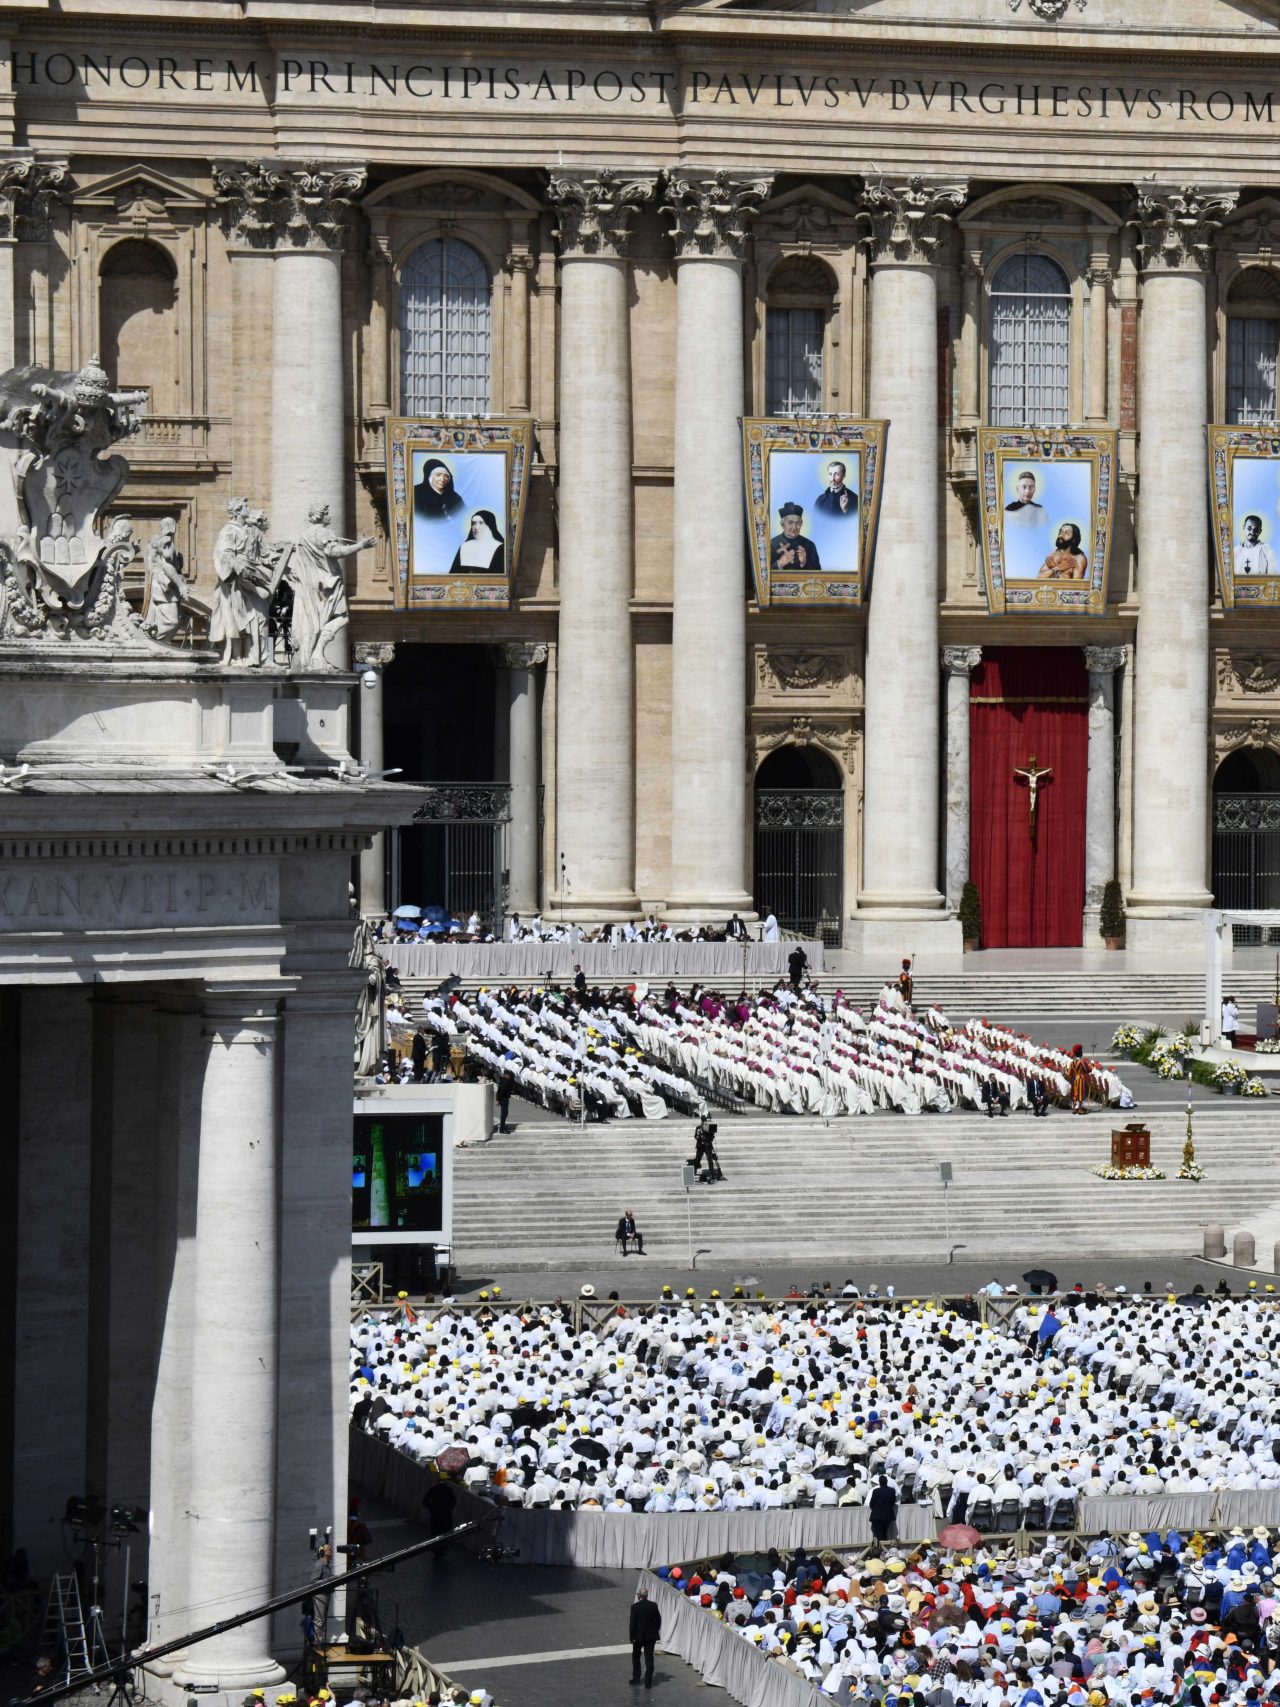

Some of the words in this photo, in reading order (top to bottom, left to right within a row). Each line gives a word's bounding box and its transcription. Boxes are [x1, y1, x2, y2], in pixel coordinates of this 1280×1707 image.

[11, 51, 259, 93] HONOREM
[281, 60, 519, 100] PRINCIPIS
[531, 68, 675, 104] APOST
[690, 71, 840, 108] PAVLVS
[848, 77, 878, 109] V
[889, 78, 1162, 119] BVRGHESIVS
[103, 873, 178, 915] VII
[239, 872, 273, 911] M
